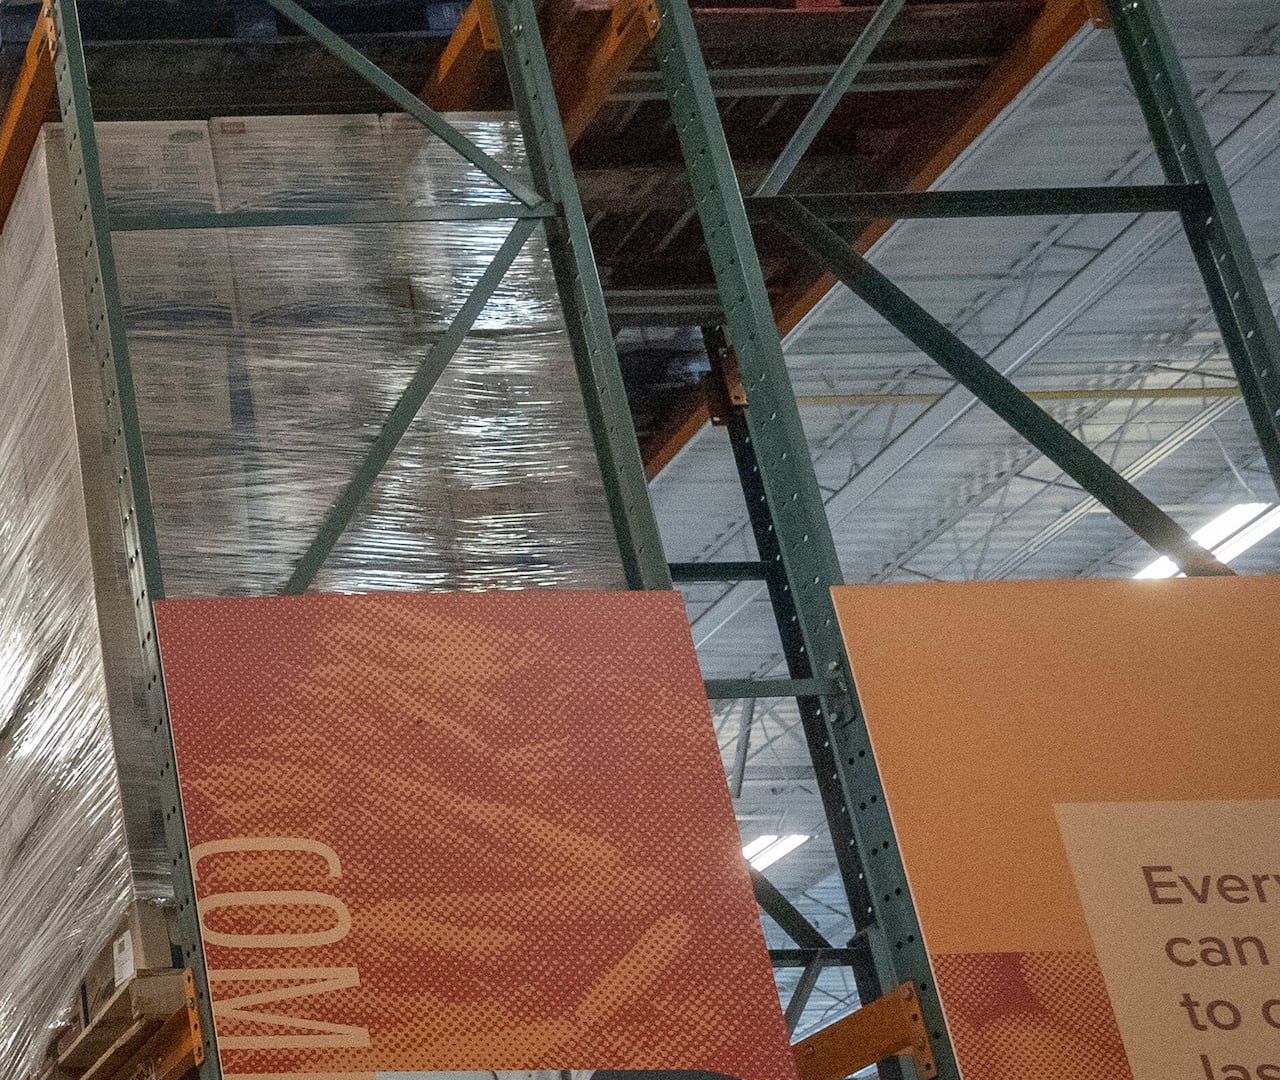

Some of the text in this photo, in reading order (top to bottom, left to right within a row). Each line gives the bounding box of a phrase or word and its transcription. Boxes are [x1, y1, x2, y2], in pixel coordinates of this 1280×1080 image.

[1142, 864, 1280, 906] Ever
[1165, 932, 1269, 969] can
[1179, 992, 1241, 1032] to
